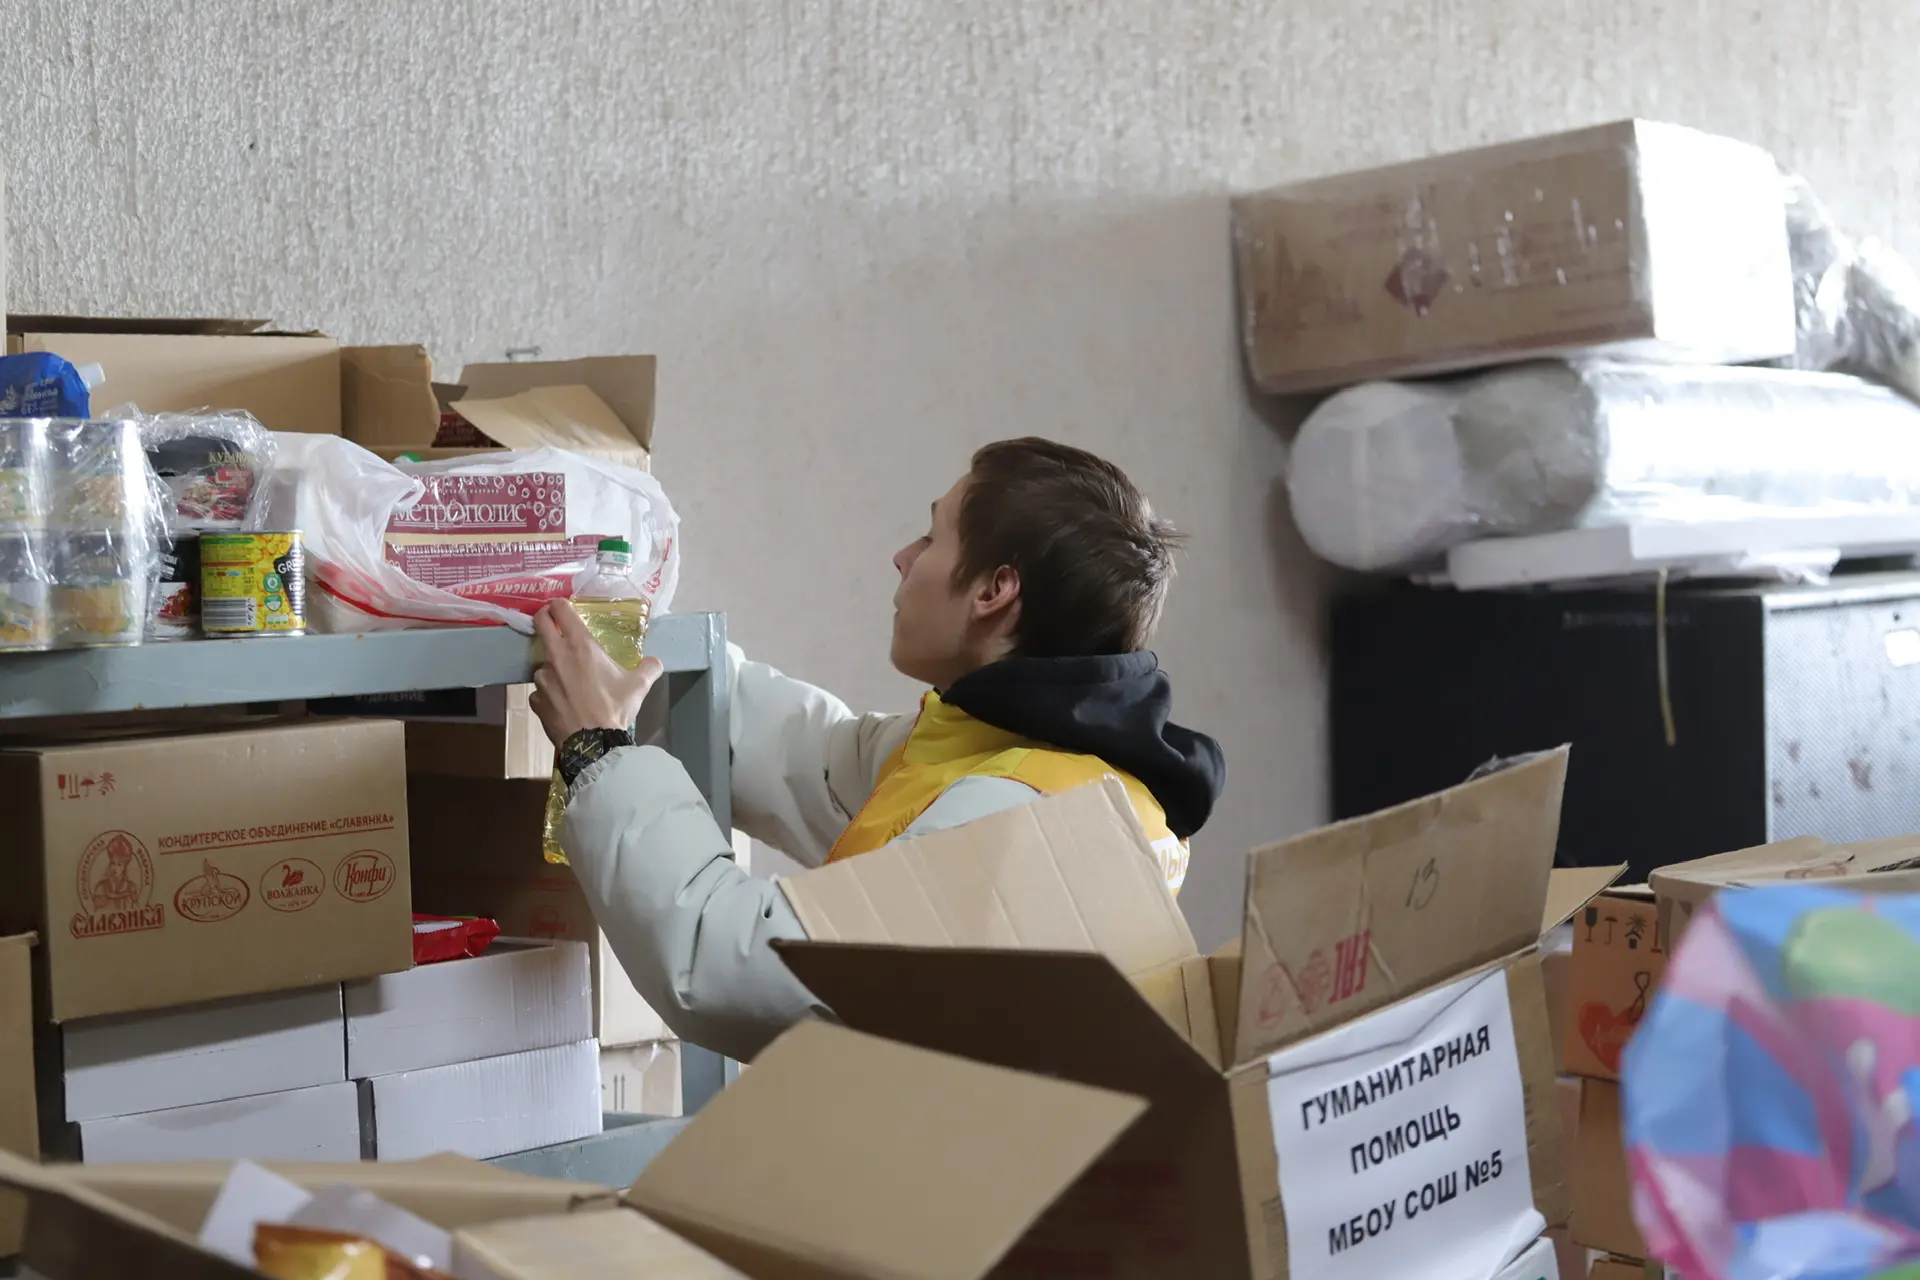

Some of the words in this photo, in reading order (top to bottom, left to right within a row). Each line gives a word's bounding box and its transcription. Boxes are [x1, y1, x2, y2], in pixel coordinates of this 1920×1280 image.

[157, 829, 247, 850] КОНДИТЕРСКОЕ
[248, 819, 328, 840] ОБЪЕДИНЕНИЕ
[329, 812, 395, 830] «СЛАВЯНКА»
[266, 884, 321, 901] ВОЛЖАНКА
[344, 857, 387, 897] Конфи
[181, 890, 242, 912] КРУПСКОЙ
[71, 905, 164, 937] СЛАВЯНКА
[1300, 1024, 1491, 1131] ГУМАНИТАРНАЯ
[1350, 1104, 1462, 1175] ПОМОЩЬ
[1328, 1199, 1396, 1256] МБОУ
[1404, 1171, 1458, 1220] СОШ
[1465, 1150, 1504, 1192] №5
